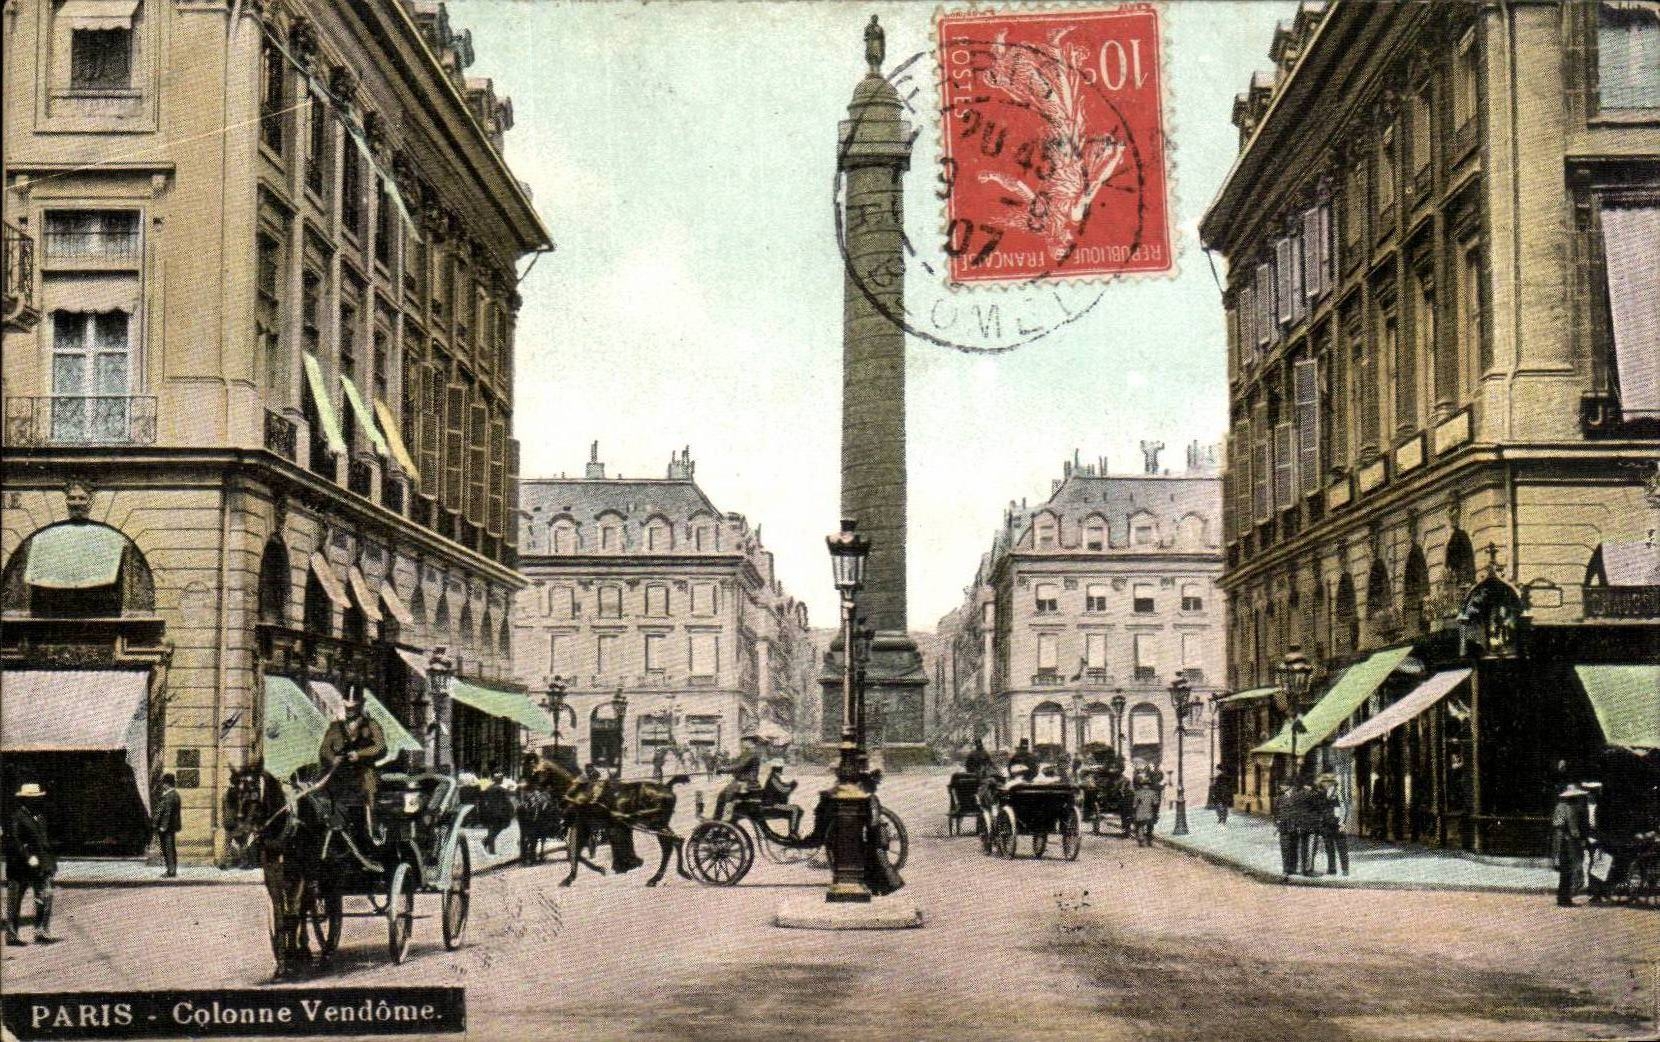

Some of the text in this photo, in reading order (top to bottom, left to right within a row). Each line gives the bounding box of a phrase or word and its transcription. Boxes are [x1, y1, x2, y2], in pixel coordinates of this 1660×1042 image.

[951, 35, 972, 119] POSTES
[1099, 38, 1149, 91] 10
[942, 217, 1005, 267] 07
